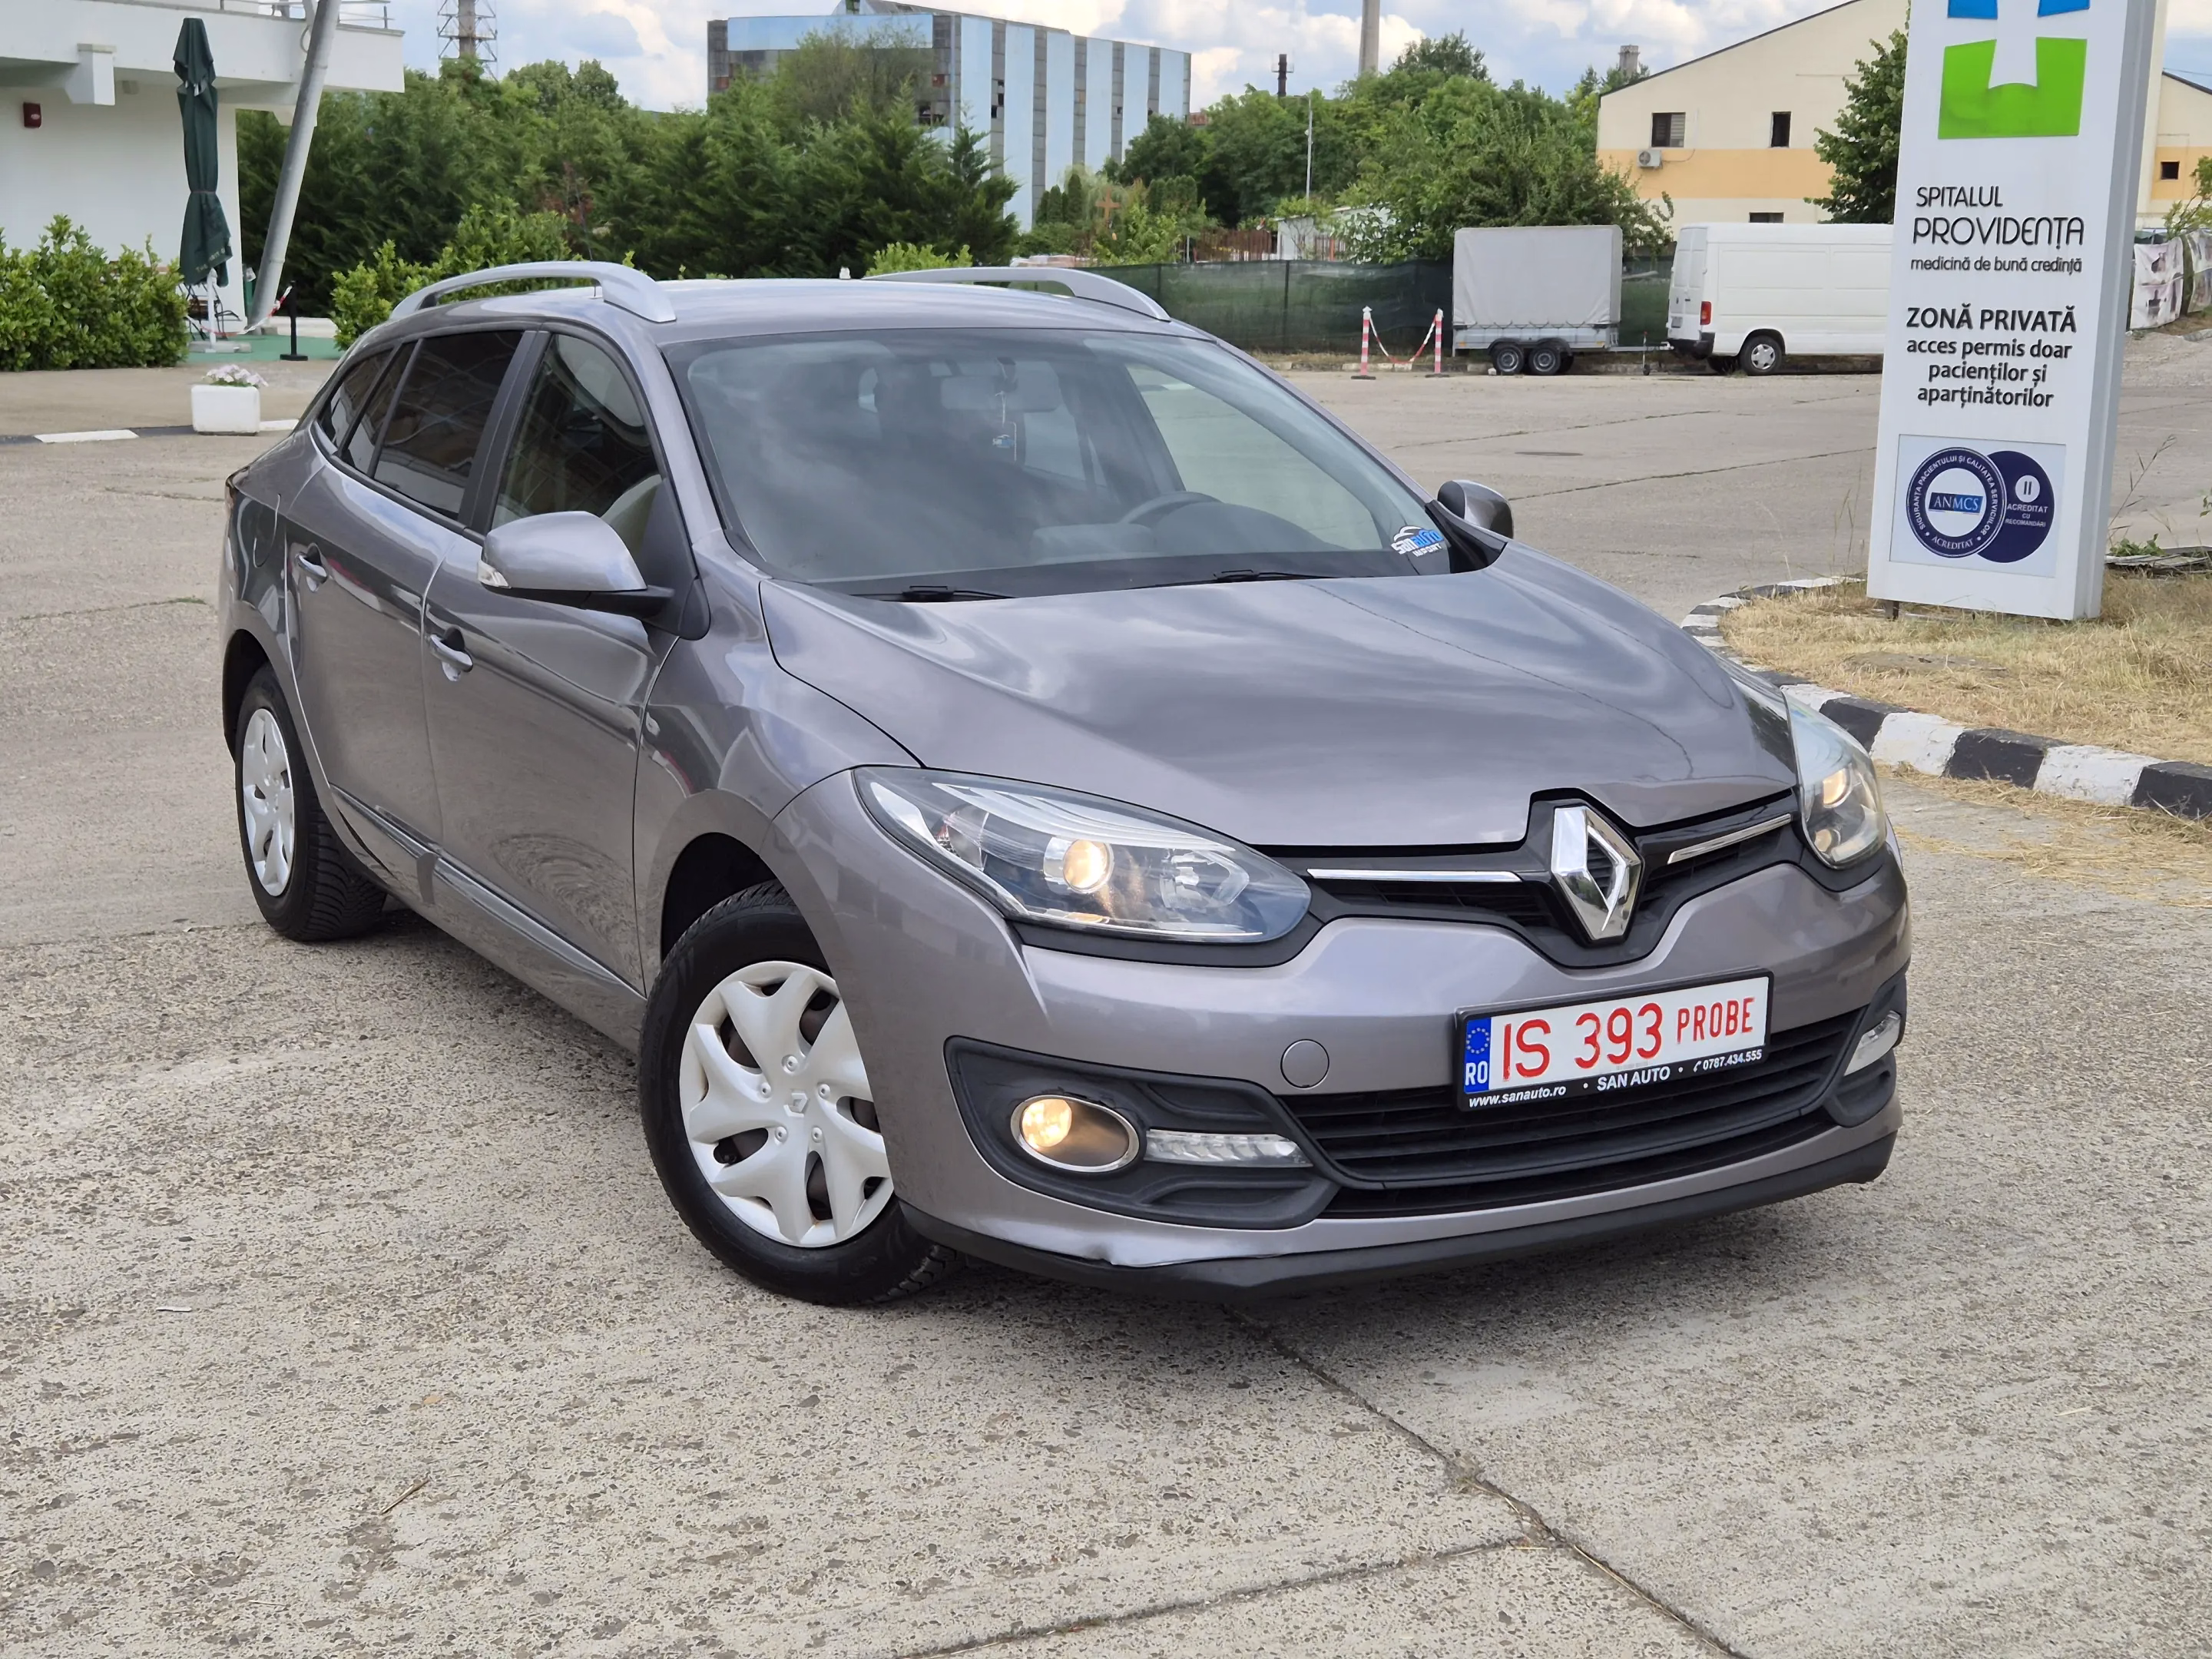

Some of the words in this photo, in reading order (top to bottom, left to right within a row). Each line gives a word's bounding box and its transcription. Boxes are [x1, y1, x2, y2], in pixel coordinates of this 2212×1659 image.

[1916, 185, 2003, 207] SPITALUL
[1912, 217, 2085, 249] PROVIDENȚA
[1910, 257, 1971, 271] medicină
[1973, 257, 1991, 271] de
[1994, 257, 2028, 272] bună
[2031, 257, 2082, 276] credință
[1906, 303, 1973, 330] ZONĂ
[1979, 305, 2077, 333] PRIVATĂ
[1906, 339, 1957, 355] acces
[1962, 338, 2025, 359] permis
[2029, 339, 2072, 359] doar
[1928, 361, 2028, 386] pacienților
[2032, 364, 2047, 387] și
[1917, 386, 2054, 409] aparținătorilor
[1918, 455, 1957, 485] PACIENTULUI
[1966, 457, 1995, 488] CALITATEA
[1934, 495, 1979, 511] ANMCS
[1980, 488, 1998, 535] SERVICIILOR
[2007, 503, 2048, 513] ACREDITAT
[1932, 536, 1973, 549] ACREDITAT
[1502, 1018, 1551, 1081] IS
[1574, 1002, 1663, 1069] 393
[1677, 996, 1755, 1045] PROBE
[1465, 1061, 1488, 1086] RO
[1469, 1084, 1567, 1108] www.sanauto.ro
[1597, 1072, 1631, 1091] SAN
[1631, 1066, 1671, 1087] AUTO
[1702, 1048, 1763, 1071] 0787.434.555
